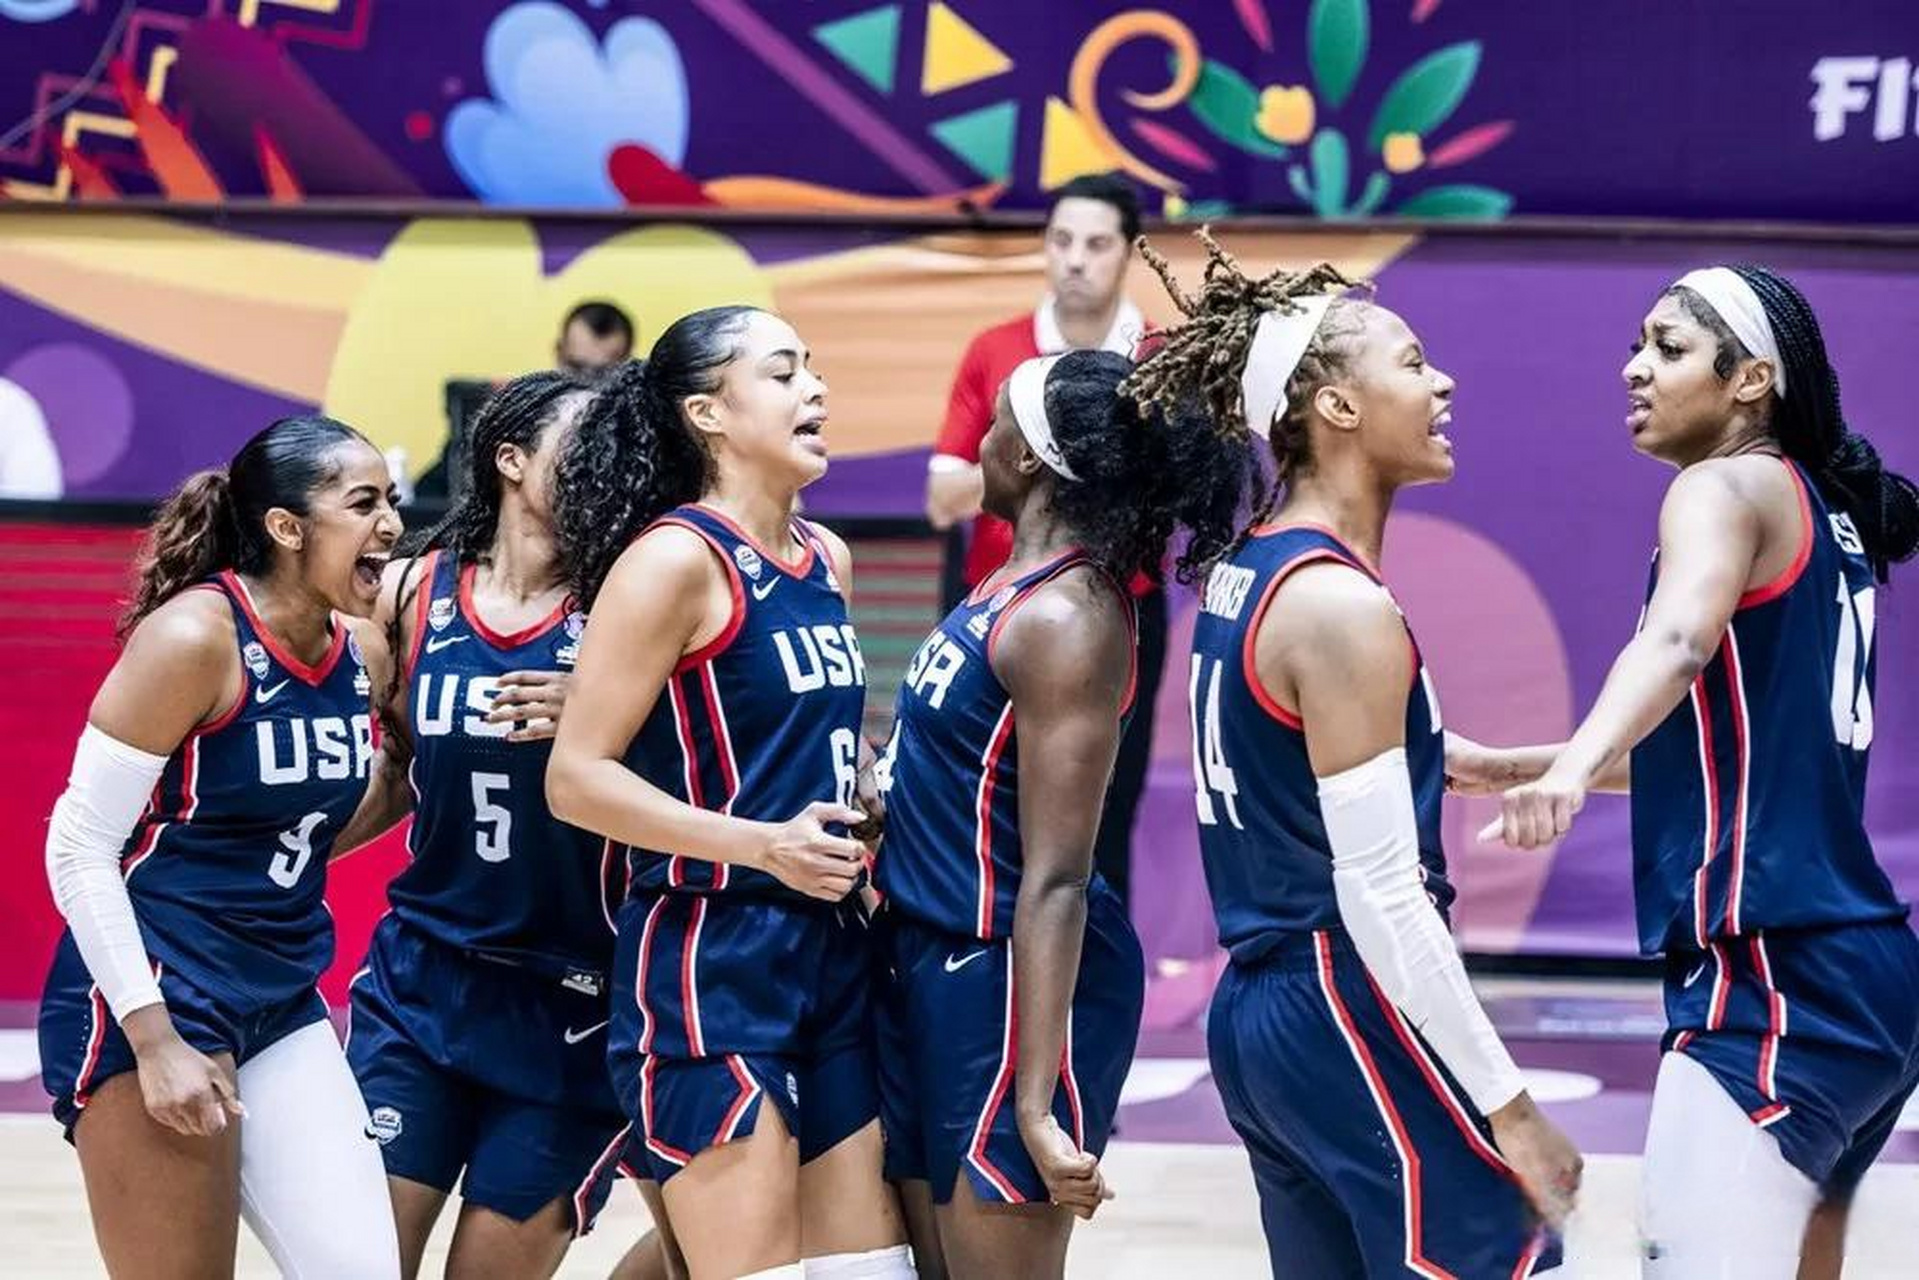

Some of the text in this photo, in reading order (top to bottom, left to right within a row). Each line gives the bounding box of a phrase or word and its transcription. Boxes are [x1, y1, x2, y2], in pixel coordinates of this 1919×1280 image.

[416, 673, 551, 738] US
[1189, 653, 1244, 830] 14
[829, 727, 857, 808] 6
[267, 811, 328, 889] 9
[471, 771, 512, 863] 5
